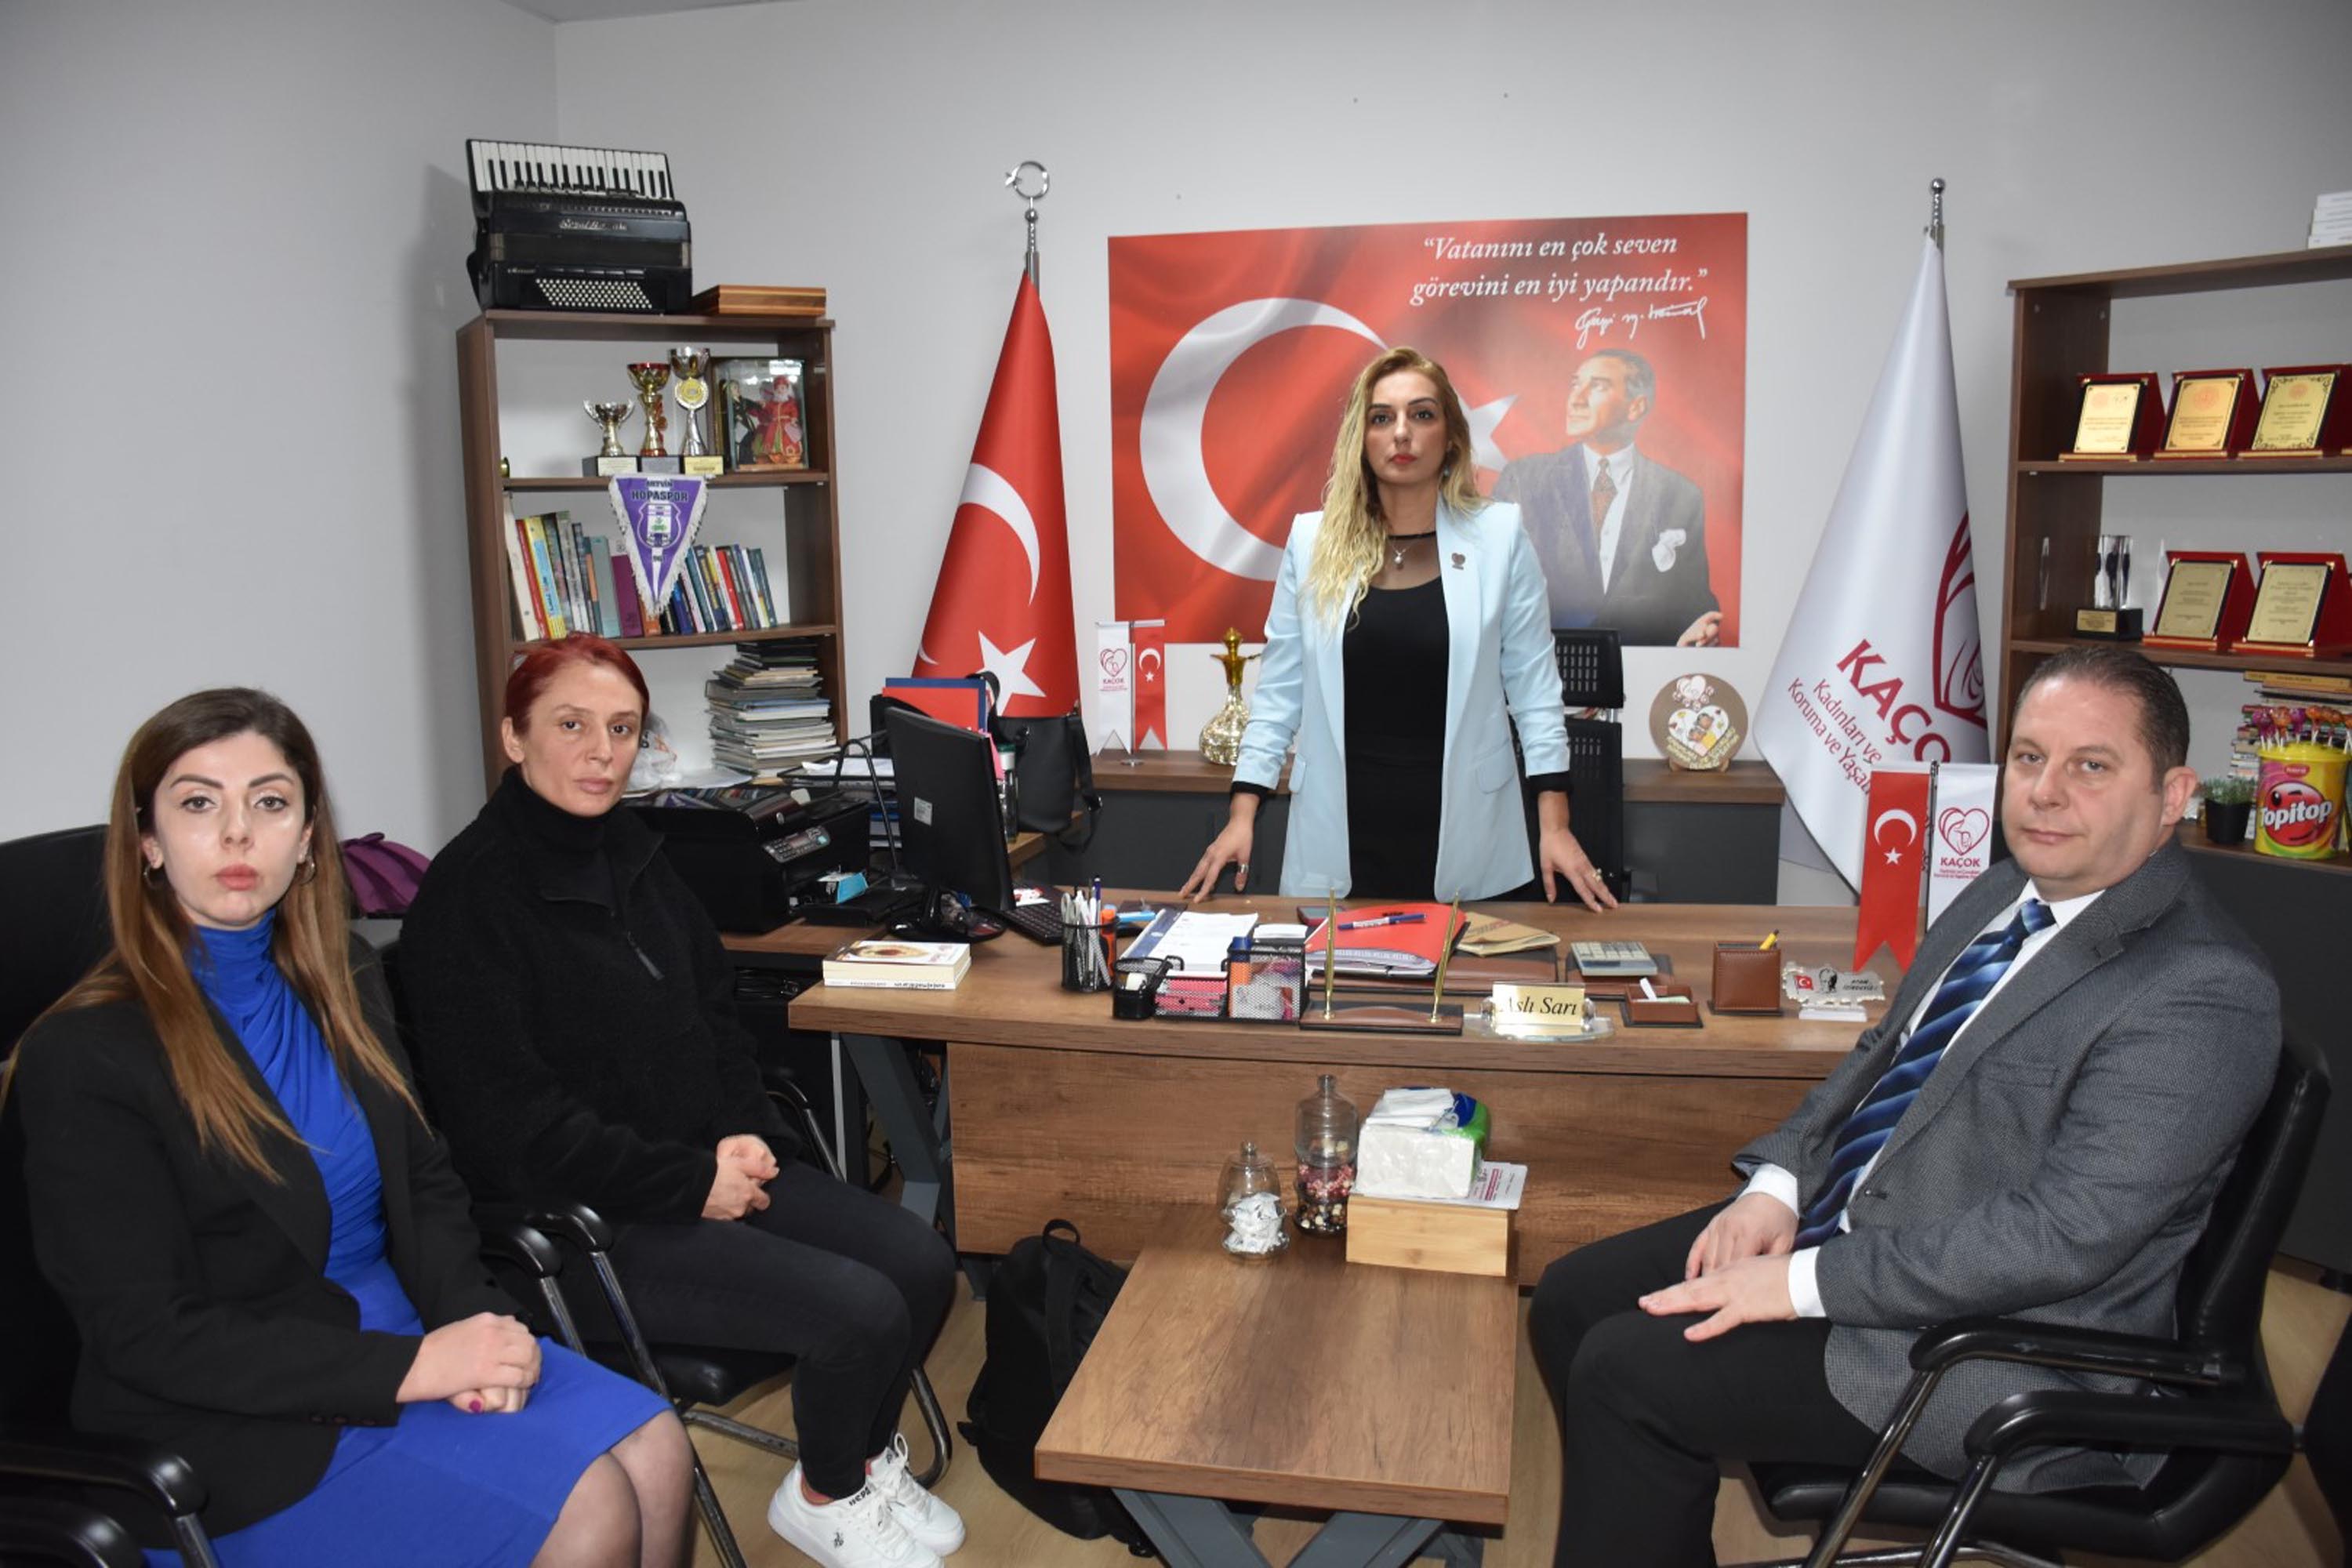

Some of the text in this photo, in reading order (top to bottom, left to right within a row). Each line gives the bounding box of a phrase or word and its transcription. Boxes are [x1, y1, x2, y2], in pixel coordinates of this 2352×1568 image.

[1539, 238, 1566, 257] en
[1572, 233, 1607, 261] çok
[1613, 238, 1678, 254] seven
[1410, 274, 1509, 306] görevini
[1514, 278, 1541, 295] en
[1548, 273, 1579, 302] iyi
[632, 490, 688, 501] HOPASPOR
[1788, 677, 1828, 737] Koruma
[1824, 732, 1842, 754] ve
[1813, 678, 1865, 746] Kadınları
[1836, 639, 1951, 763] KAÇO
[2261, 800, 2332, 830] Topitop
[1940, 857, 1980, 869] KAÇOK
[1540, 996, 1577, 1016] Sarı
